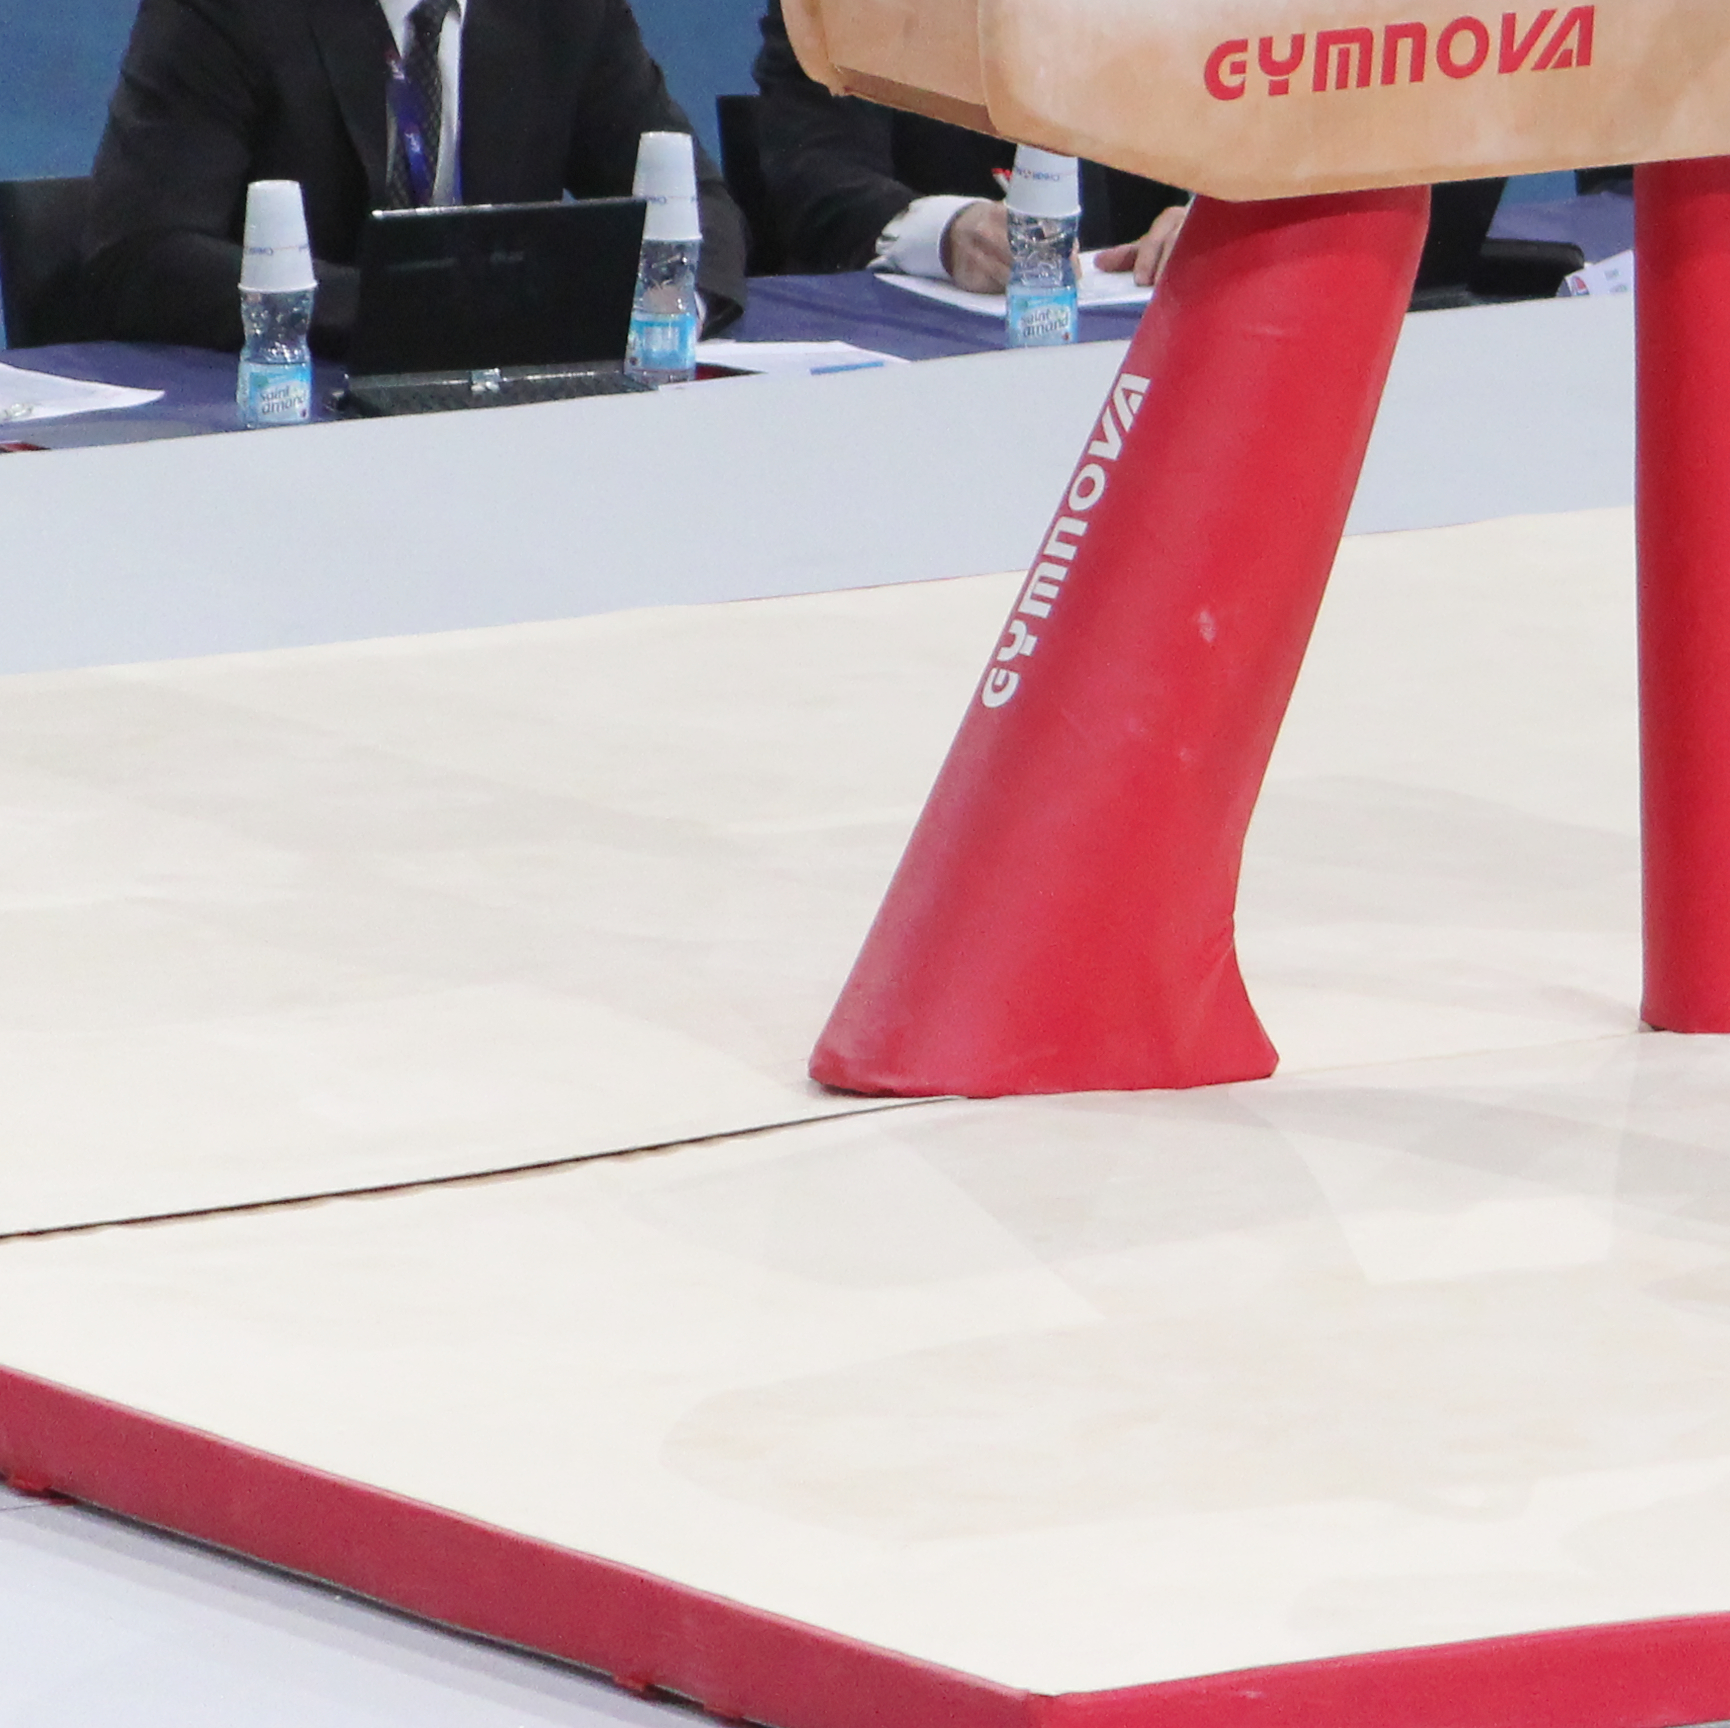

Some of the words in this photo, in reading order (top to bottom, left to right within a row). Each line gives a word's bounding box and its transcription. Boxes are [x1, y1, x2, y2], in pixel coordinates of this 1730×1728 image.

[1203, 4, 1596, 101] GYMNOVA
[1022, 310, 1070, 338] amand
[260, 385, 290, 402] saint
[981, 372, 1151, 709] GYMNOVA
